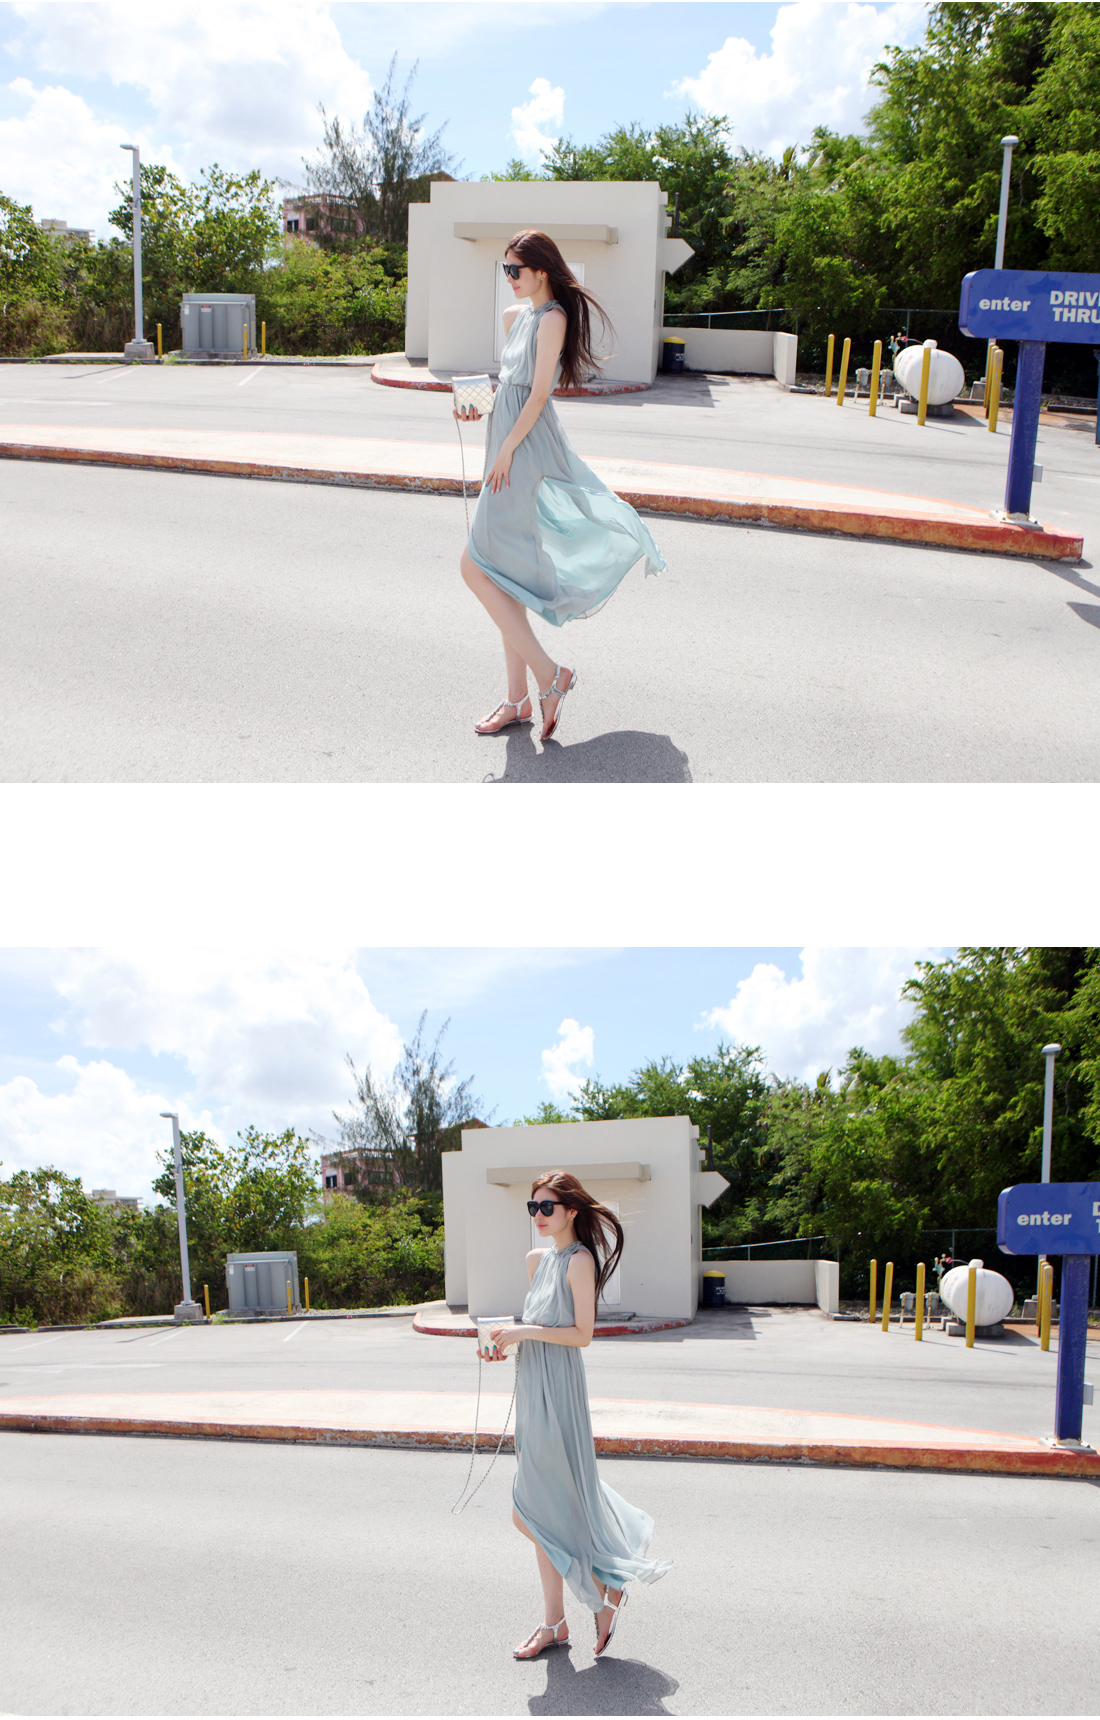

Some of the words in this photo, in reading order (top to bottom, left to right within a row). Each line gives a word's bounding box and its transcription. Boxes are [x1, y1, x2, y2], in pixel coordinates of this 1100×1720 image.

[979, 297, 1031, 312] enter
[1049, 290, 1100, 307] DRIV
[1052, 307, 1100, 324] THRU
[1016, 1211, 1072, 1226] enter
